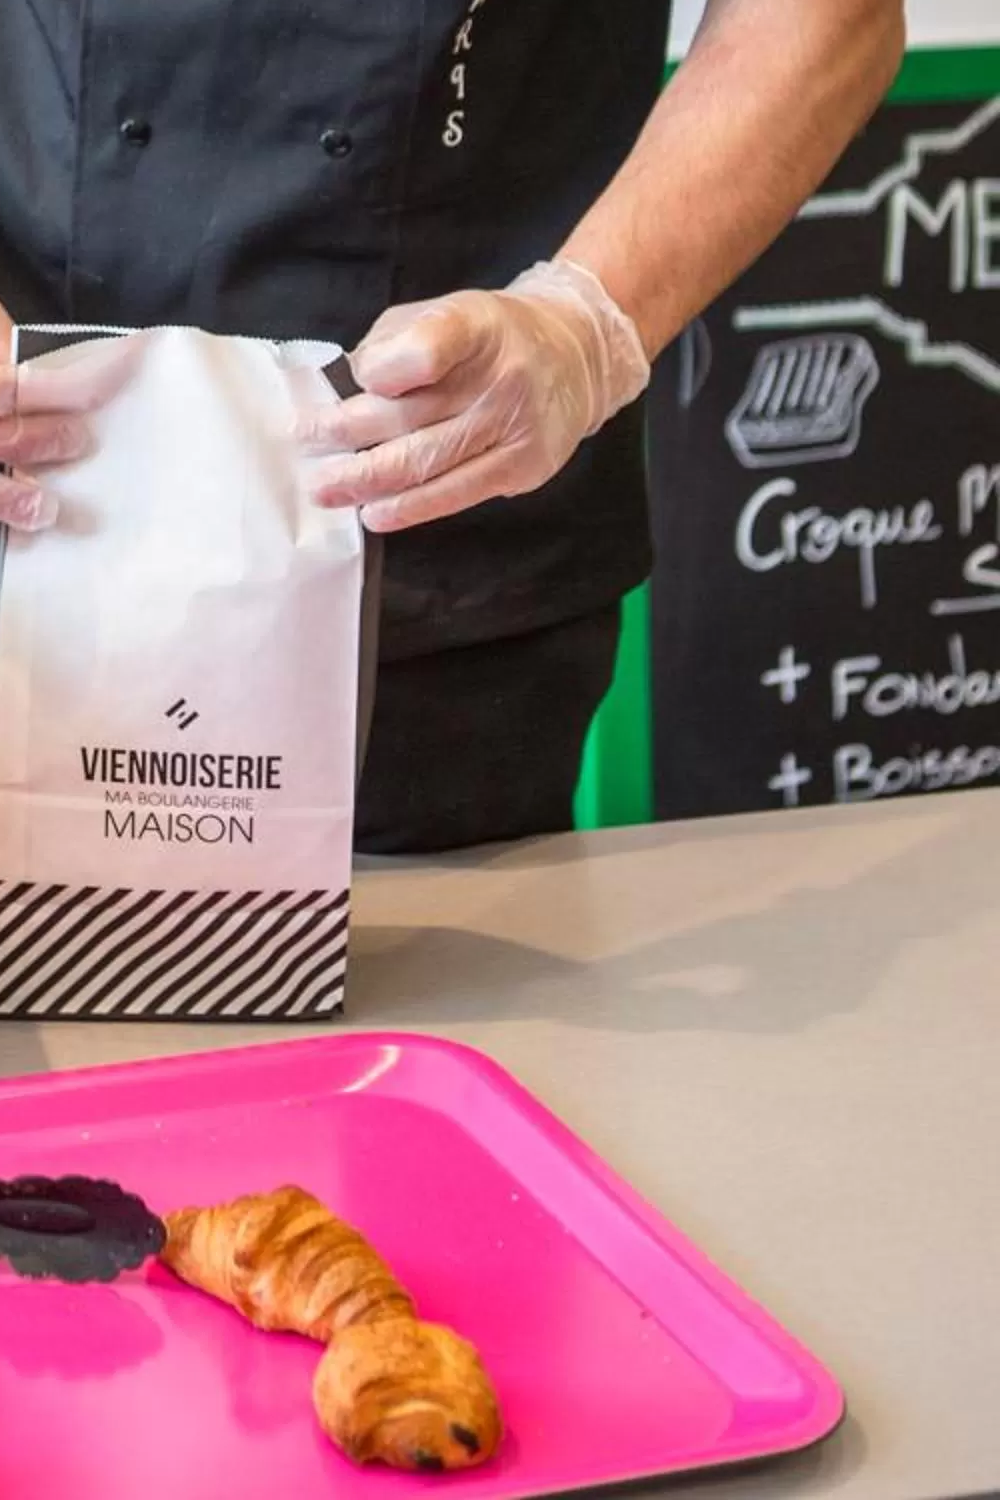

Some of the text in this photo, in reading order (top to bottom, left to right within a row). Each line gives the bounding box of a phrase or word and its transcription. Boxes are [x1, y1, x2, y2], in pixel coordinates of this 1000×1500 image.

[736, 478, 943, 609] Croque
[80, 746, 283, 790] VIENNOISERIE
[104, 789, 255, 811] MA BOULANGERIE
[103, 809, 254, 844] MAISON
